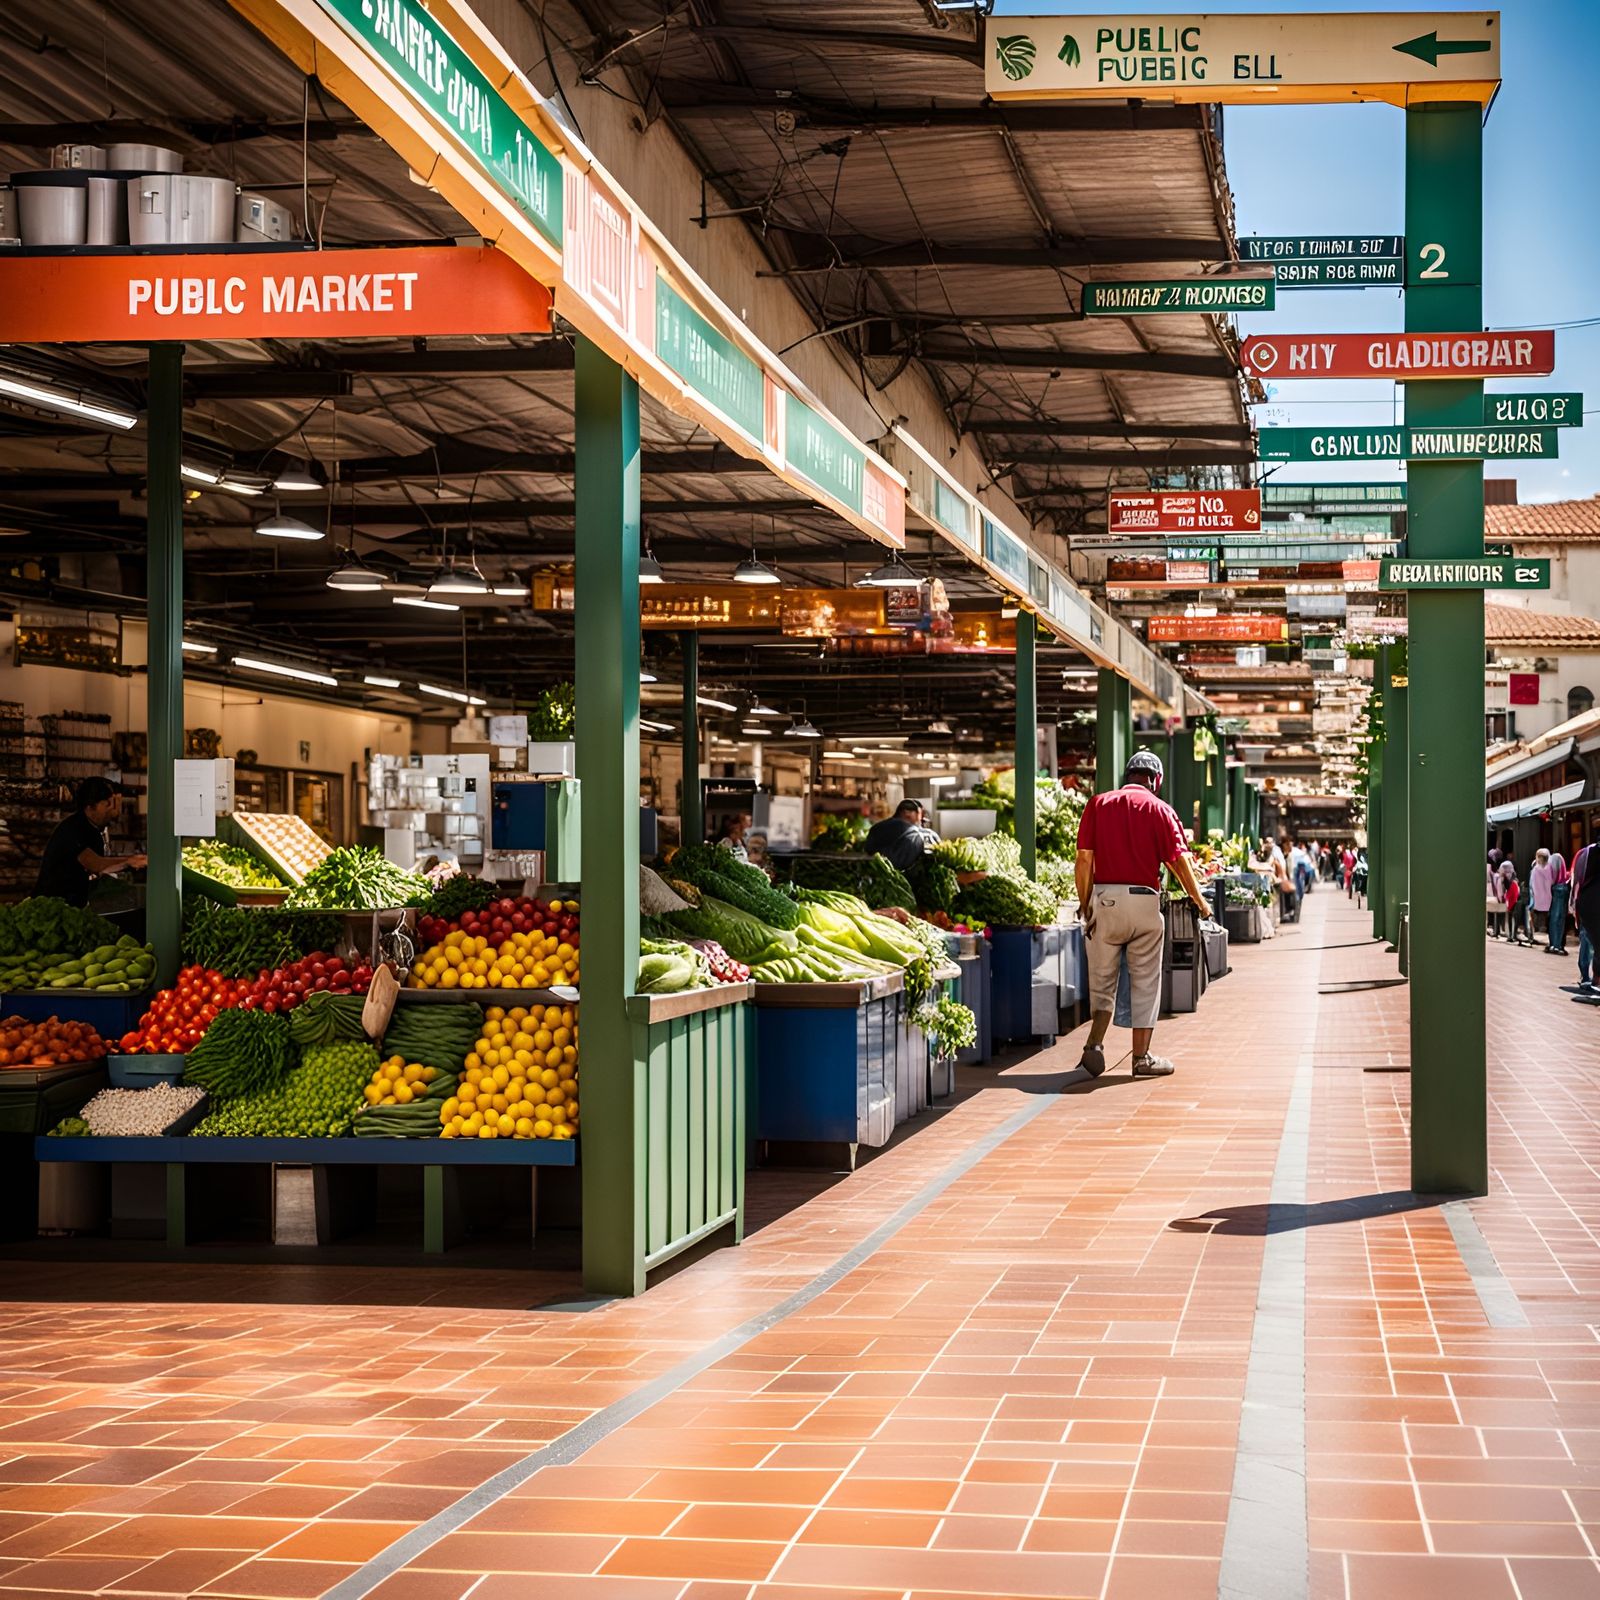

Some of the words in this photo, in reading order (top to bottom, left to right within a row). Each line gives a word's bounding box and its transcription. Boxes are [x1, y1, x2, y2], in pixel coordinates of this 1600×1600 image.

[1419, 243, 1449, 279] 2
[129, 277, 245, 315] PUBLC
[262, 272, 418, 313] MARKET
